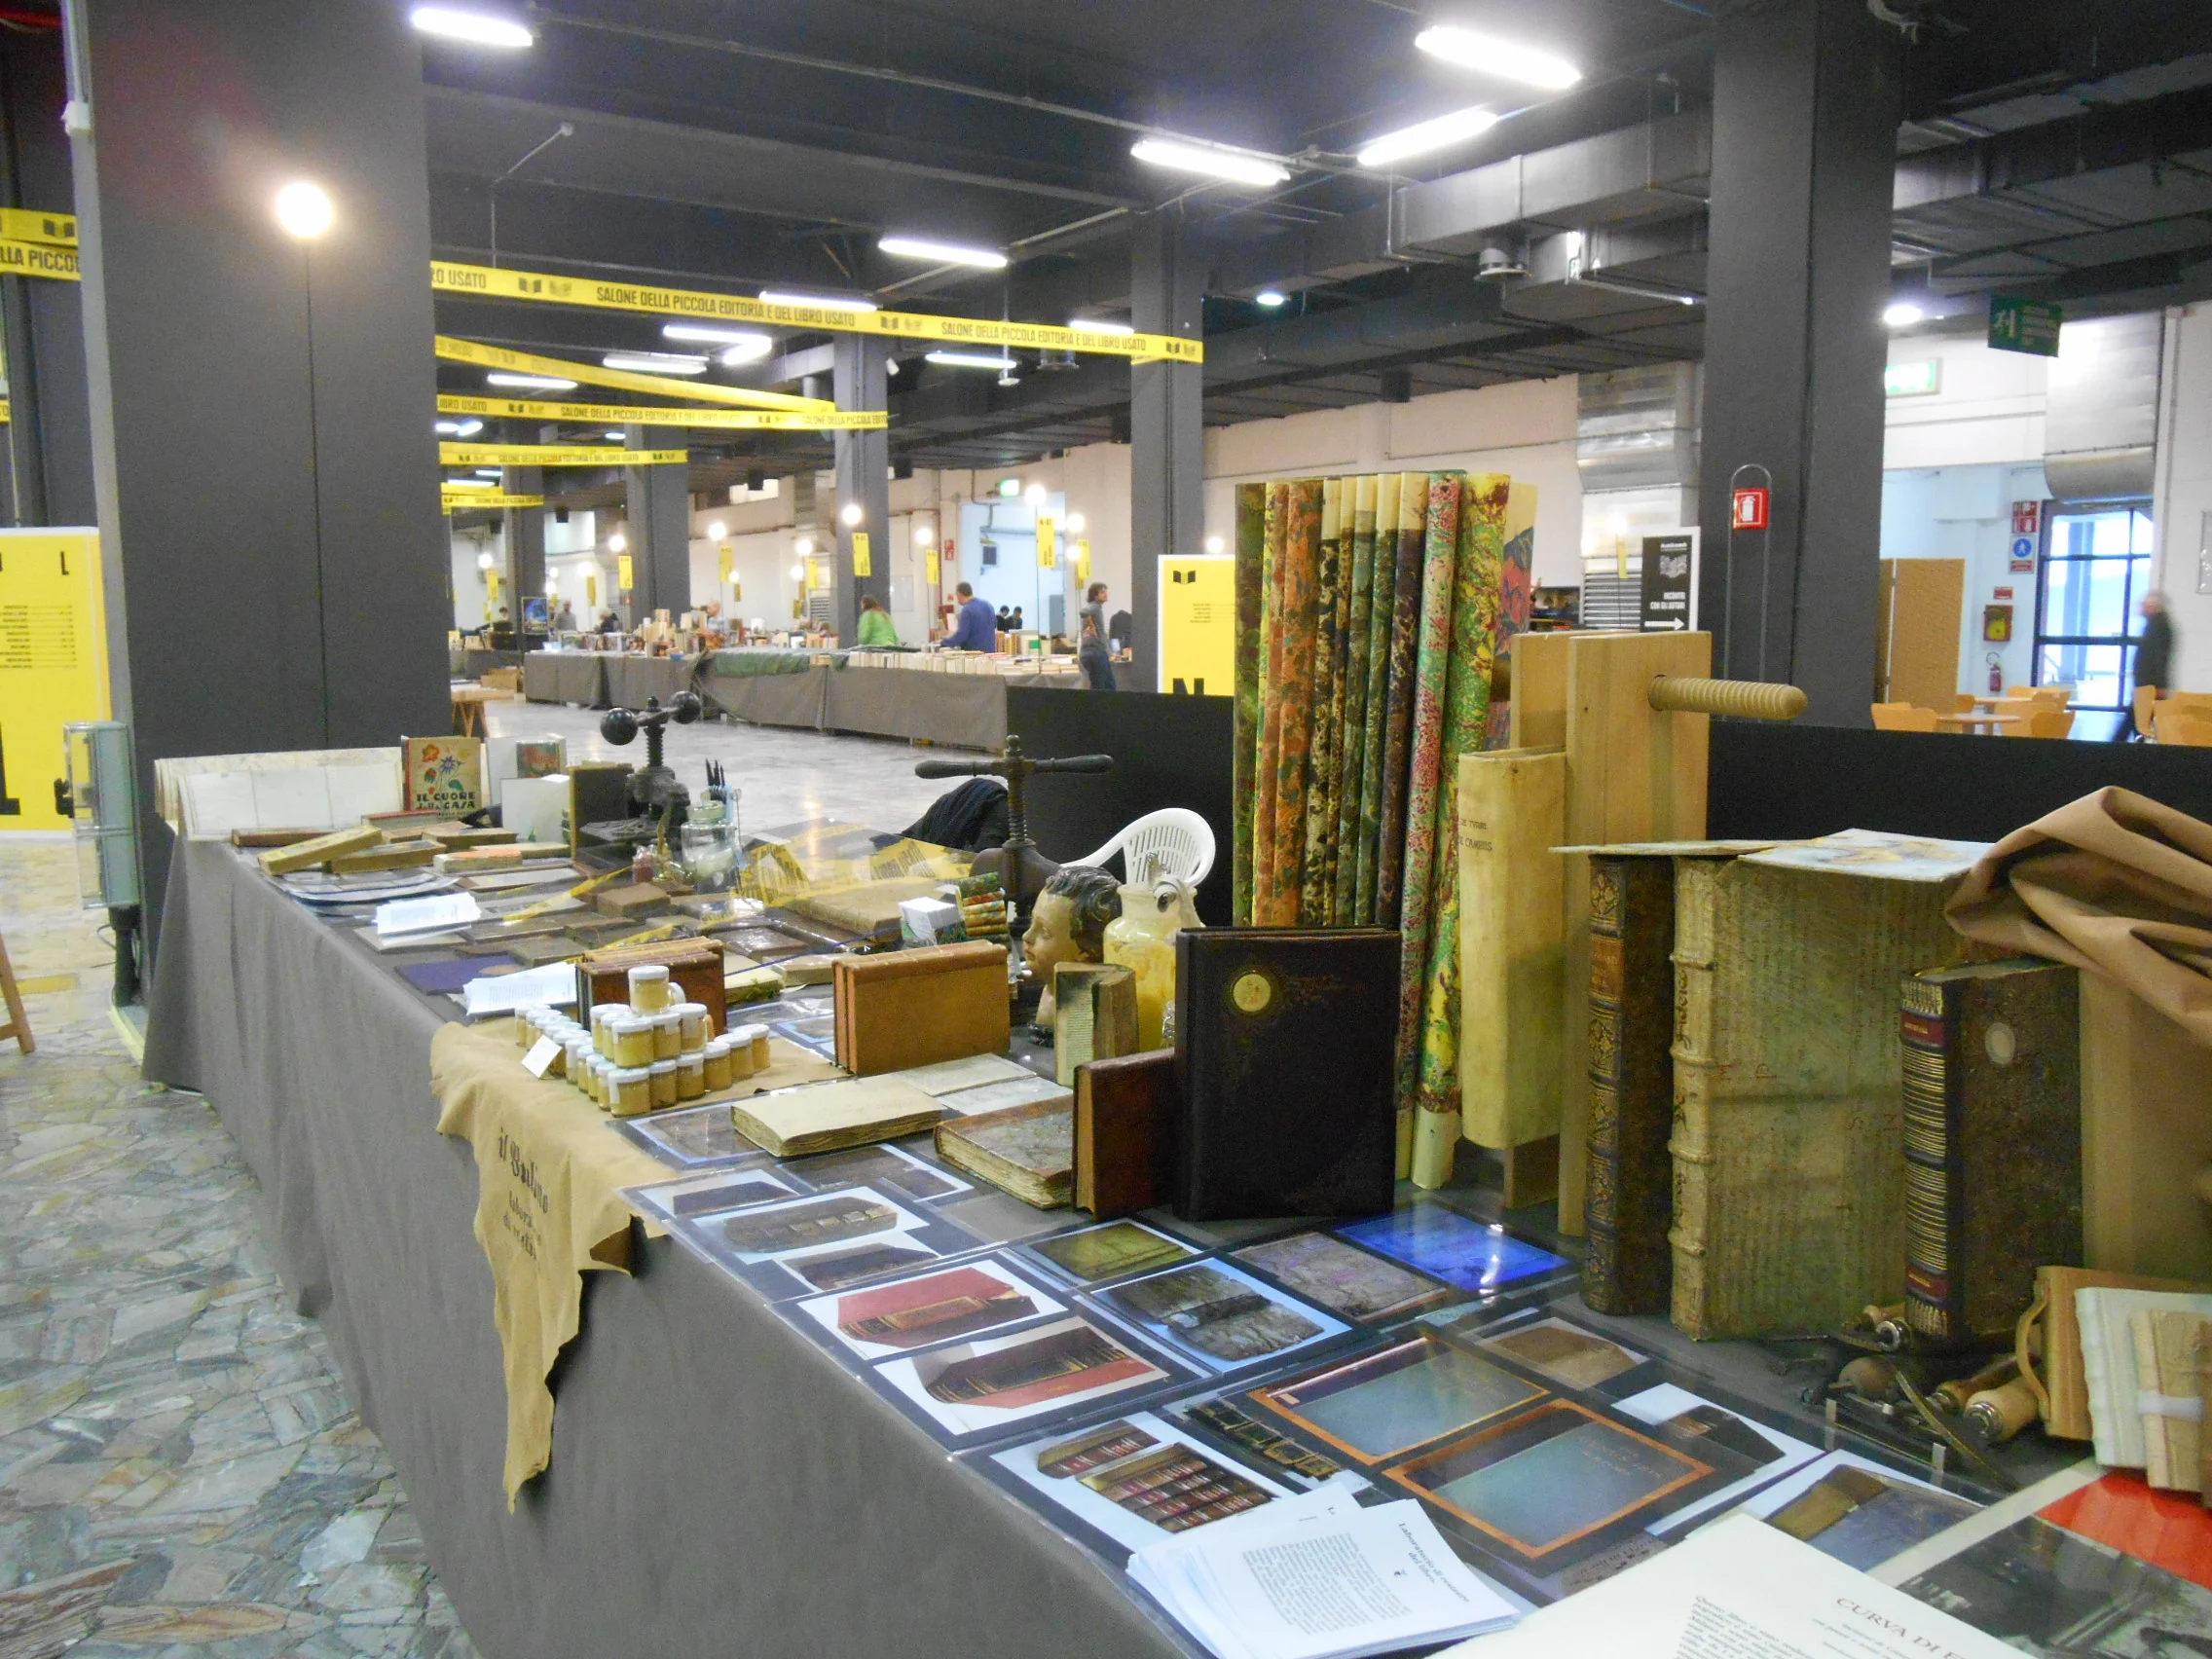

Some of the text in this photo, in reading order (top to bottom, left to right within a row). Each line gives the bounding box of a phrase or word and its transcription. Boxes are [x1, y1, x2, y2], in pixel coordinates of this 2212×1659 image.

[448, 270, 487, 289] USATO
[596, 286, 856, 327] SALONE DELLA PICCOLA EDITORIA E DEL LIBRO USATO
[941, 321, 974, 337] SALONE
[976, 325, 999, 339] DELLA
[1001, 327, 1035, 342] PICCOLA
[1038, 330, 1074, 346] EDITORIA
[1083, 334, 1095, 348] DEL
[1097, 336, 1120, 350] LIBRO
[1122, 338, 1147, 351] USATO
[461, 399, 488, 412] USATO
[561, 406, 588, 419] SALONE
[590, 408, 610, 419] DELLA
[612, 409, 643, 420] PICCOLA
[416, 792, 475, 802] IL CUORE
[1836, 1597, 1908, 1638] CURVA
[1912, 1635, 1942, 1653] DI
